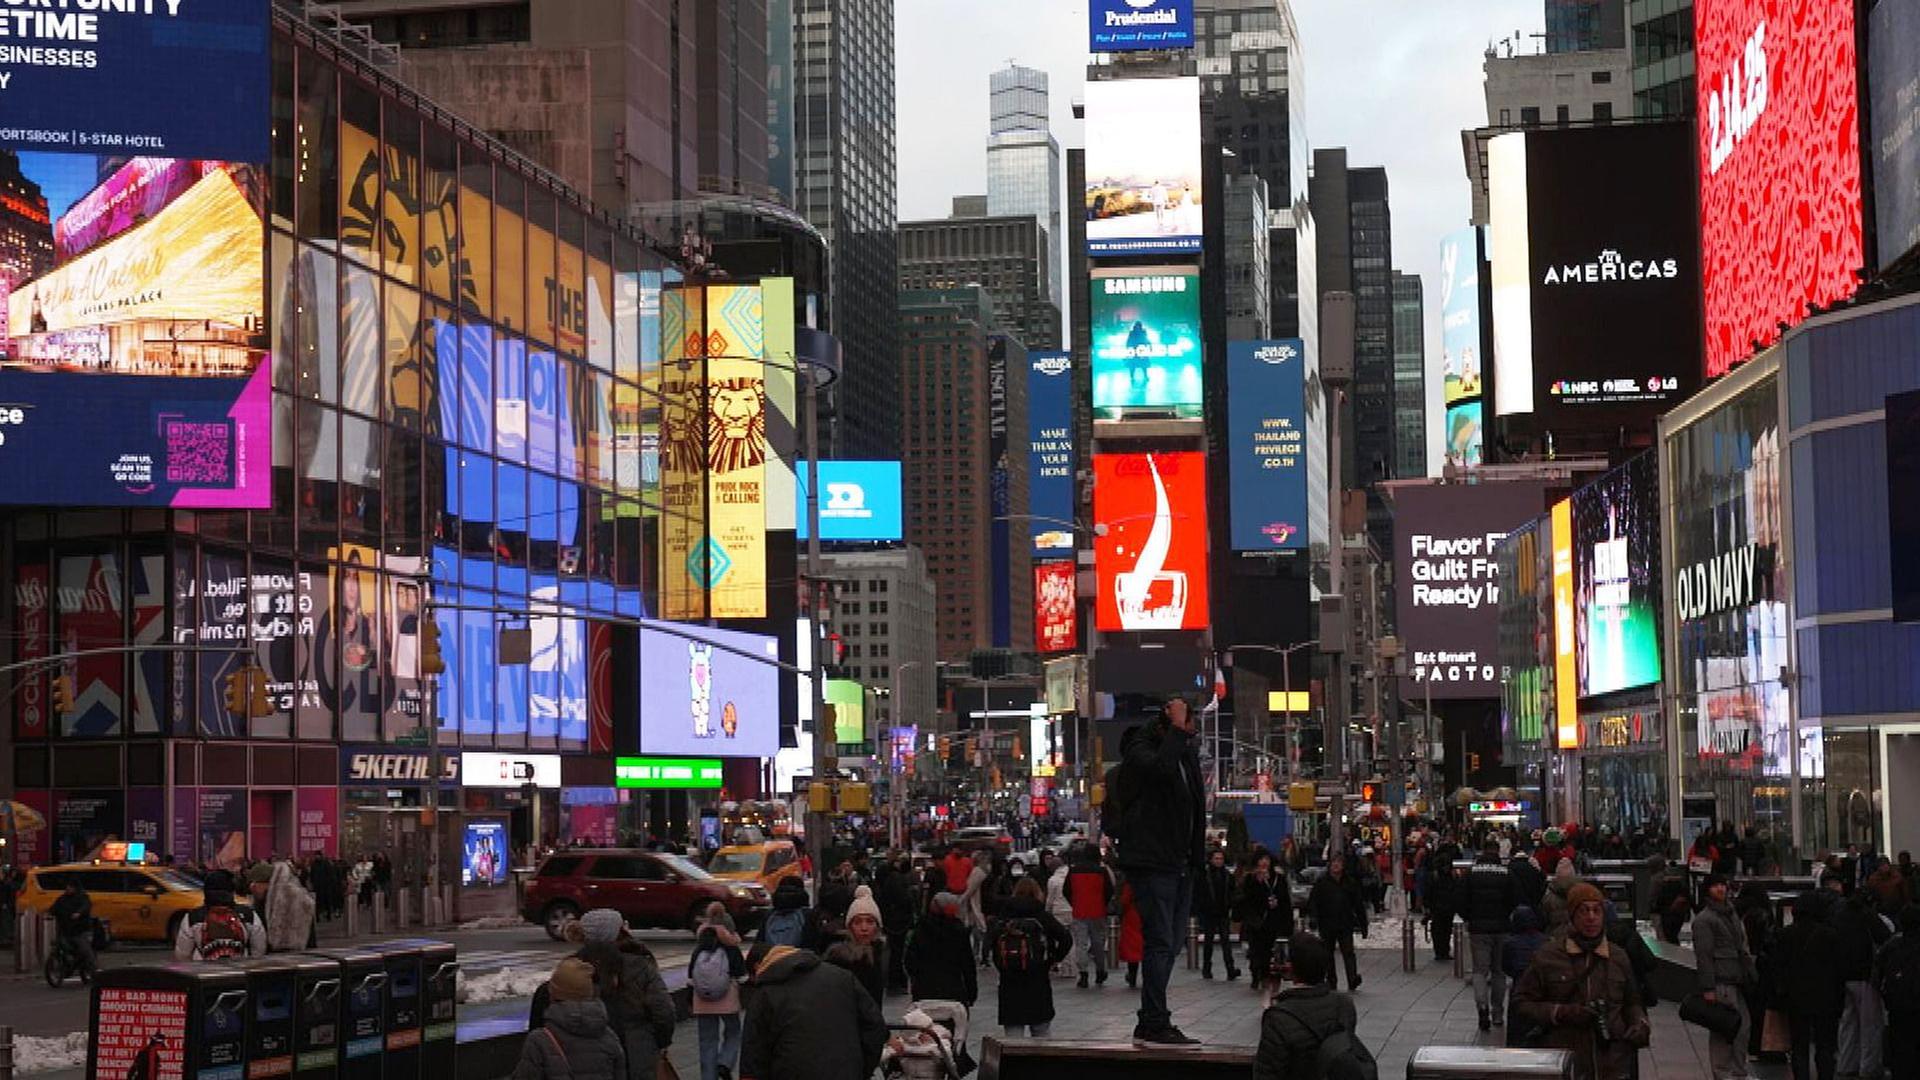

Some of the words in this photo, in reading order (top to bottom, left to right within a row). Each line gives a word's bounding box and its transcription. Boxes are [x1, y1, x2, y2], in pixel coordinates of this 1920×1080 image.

[1105, 9, 1177, 26] Prudential
[0, 127, 70, 143] ORTSBOOK
[79, 132, 123, 146] 5-STAR
[125, 136, 165, 148] HOTEL
[1544, 260, 1678, 285] AMERICAS
[1104, 276, 1186, 295] SAMSUNG
[1040, 428, 1068, 438] MAKE
[1255, 433, 1300, 442] THAILAND
[1041, 454, 1069, 464] YOUR
[1041, 467, 1070, 476] HOME
[722, 493, 760, 504] CALLING
[1411, 535, 1482, 557] Flavor
[1412, 559, 1467, 581] Guilt
[1678, 563, 1709, 621] OLD
[1709, 543, 1757, 614] NAVY
[1413, 583, 1482, 608] Ready
[101, 990, 120, 1001] JAM
[126, 992, 146, 1001] BAD
[152, 992, 187, 1003] MONEY
[100, 1001, 139, 1012] SMOOTH
[141, 1004, 185, 1014] CRIMINAL
[99, 1035, 119, 1045] CAN
[121, 1037, 142, 1046] YOU
